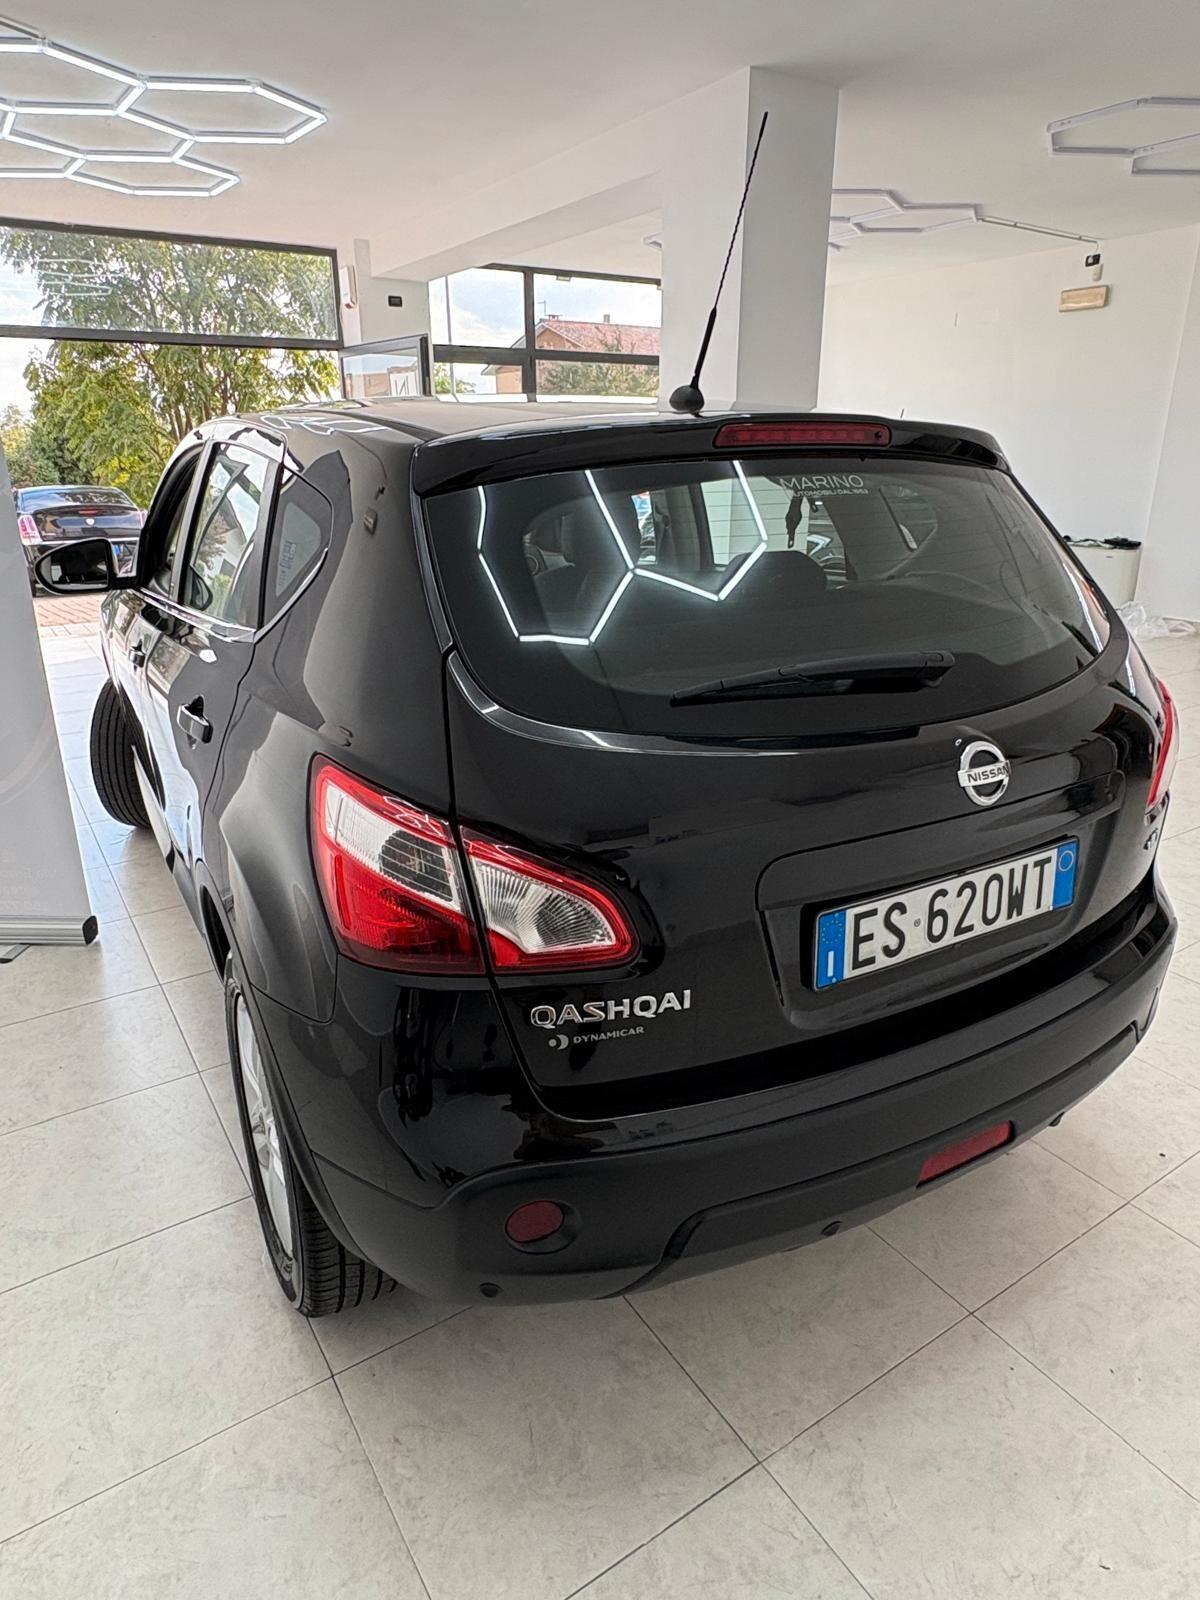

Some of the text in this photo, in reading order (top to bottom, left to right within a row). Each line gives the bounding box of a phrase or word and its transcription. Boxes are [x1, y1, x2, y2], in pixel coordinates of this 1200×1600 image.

[779, 475, 864, 490] MARINO
[967, 763, 1009, 783] NISSAN
[851, 856, 1055, 970] ES 620WT
[530, 989, 692, 1029] QASHQAI
[573, 1026, 645, 1044] DYNAMICAR
